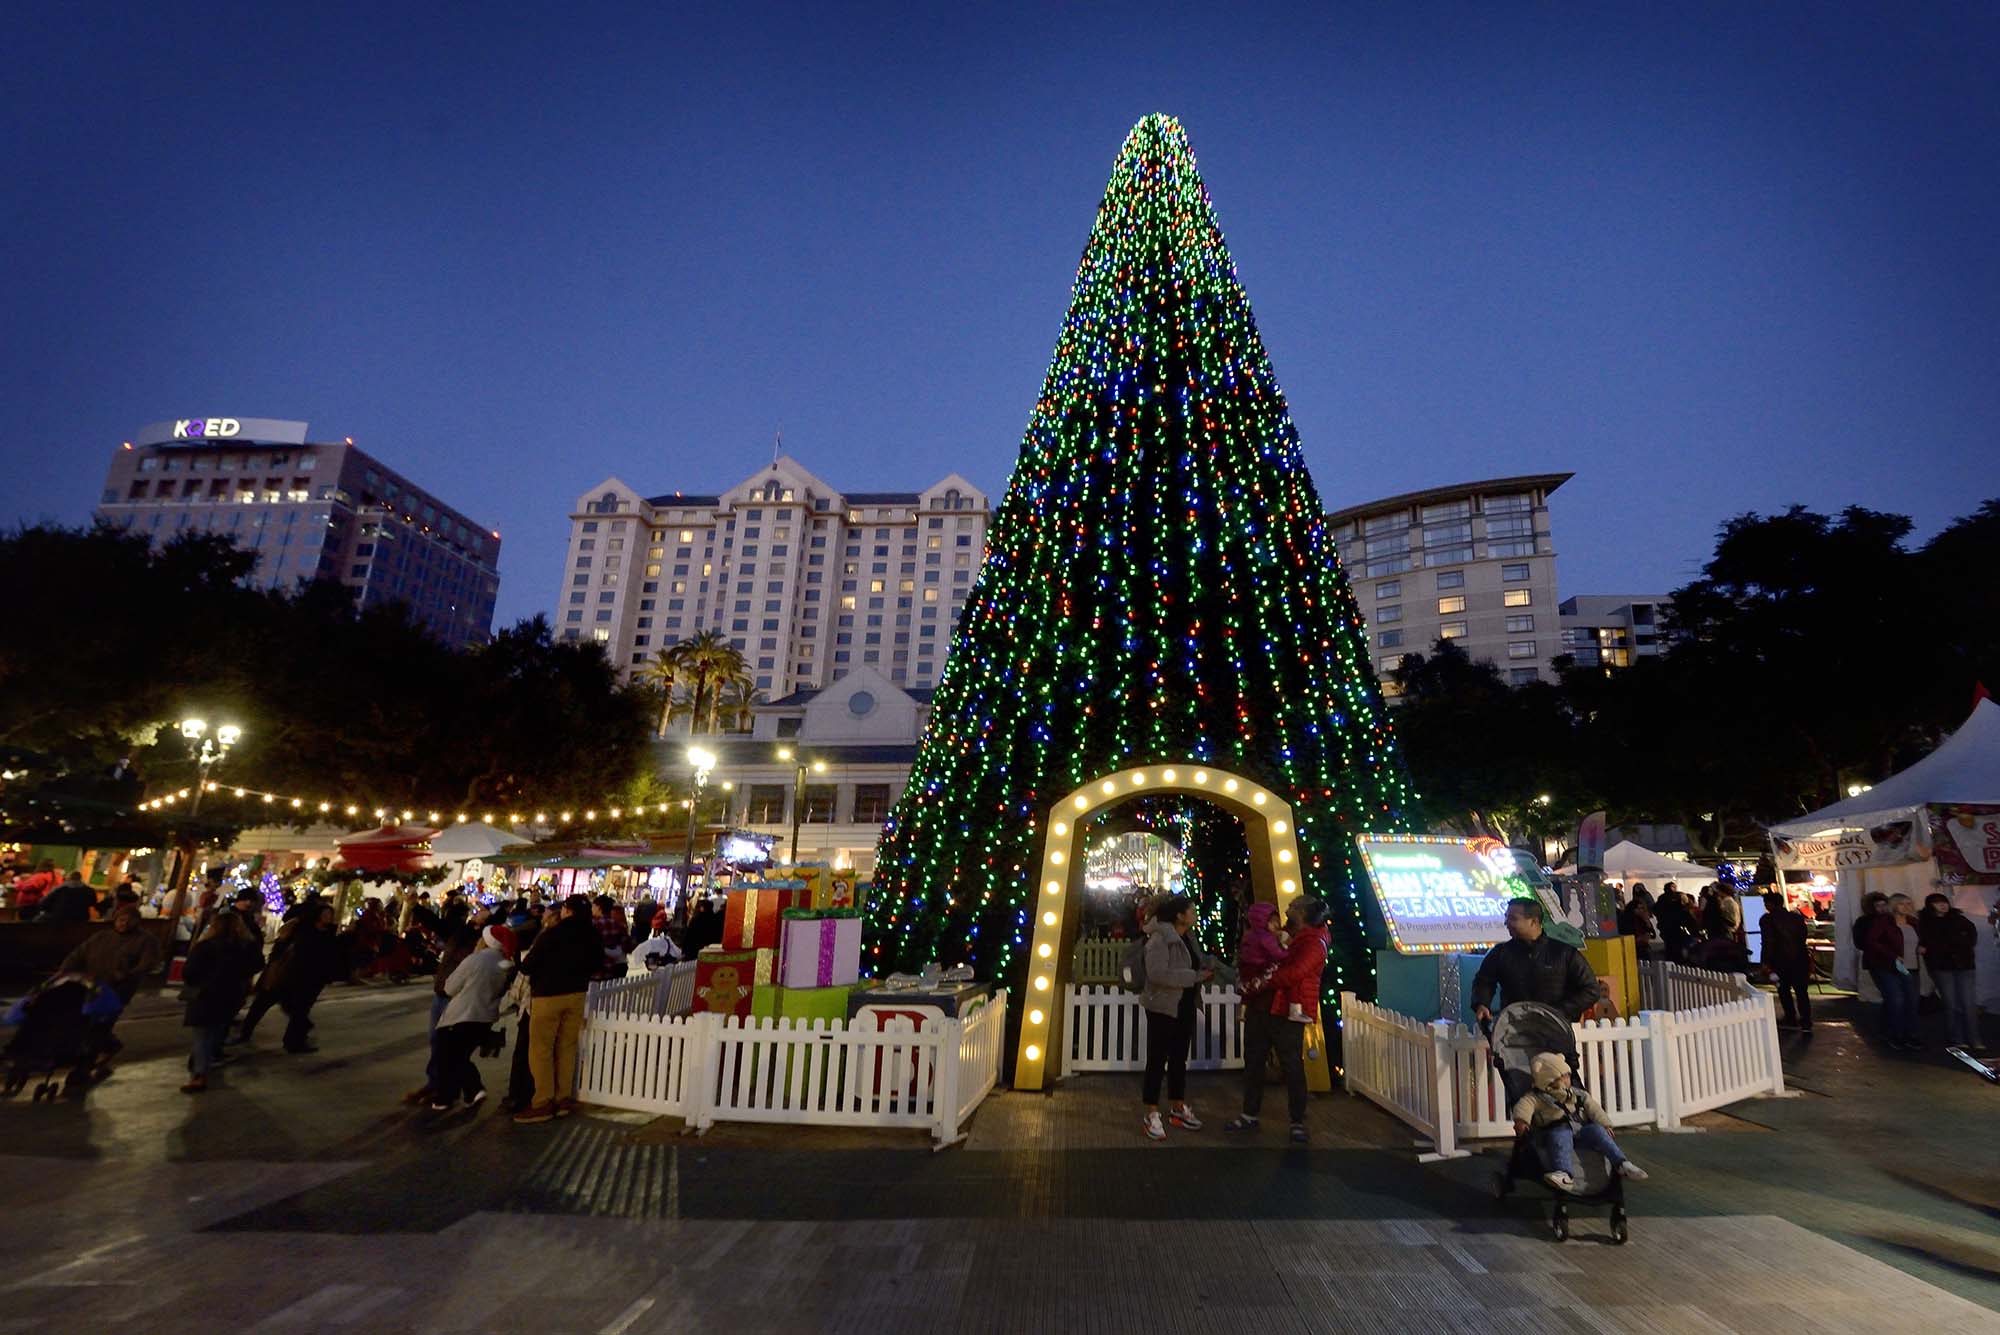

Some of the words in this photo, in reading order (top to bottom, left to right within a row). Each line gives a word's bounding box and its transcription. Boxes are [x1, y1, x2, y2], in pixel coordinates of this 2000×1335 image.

[174, 418, 240, 438] KQED
[1390, 897, 1451, 918] CLEAN
[1452, 896, 1508, 917] ENERG
[1406, 922, 1442, 934] Program
[1467, 920, 1484, 932] City
